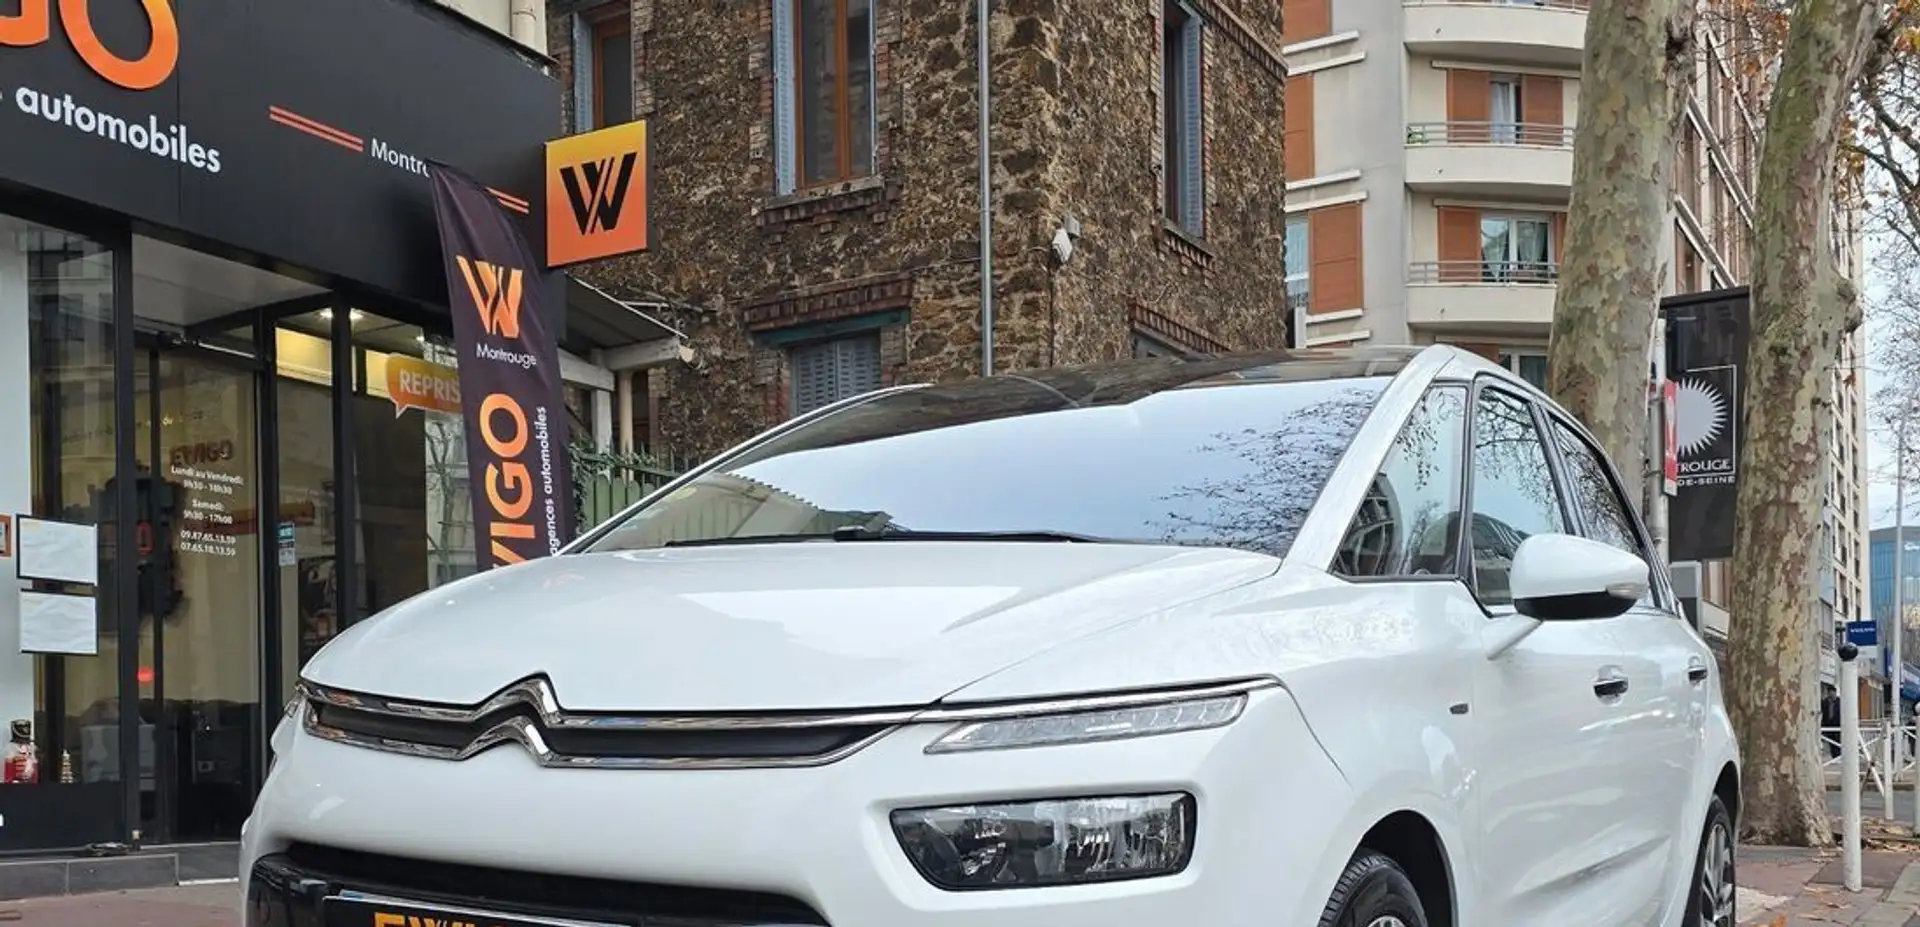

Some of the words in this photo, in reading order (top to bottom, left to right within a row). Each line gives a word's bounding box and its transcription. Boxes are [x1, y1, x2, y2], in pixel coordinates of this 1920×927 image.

[15, 86, 222, 173] automobiles
[475, 342, 537, 369] Montrouge
[533, 405, 553, 495] automobiles
[544, 499, 560, 556] agences
